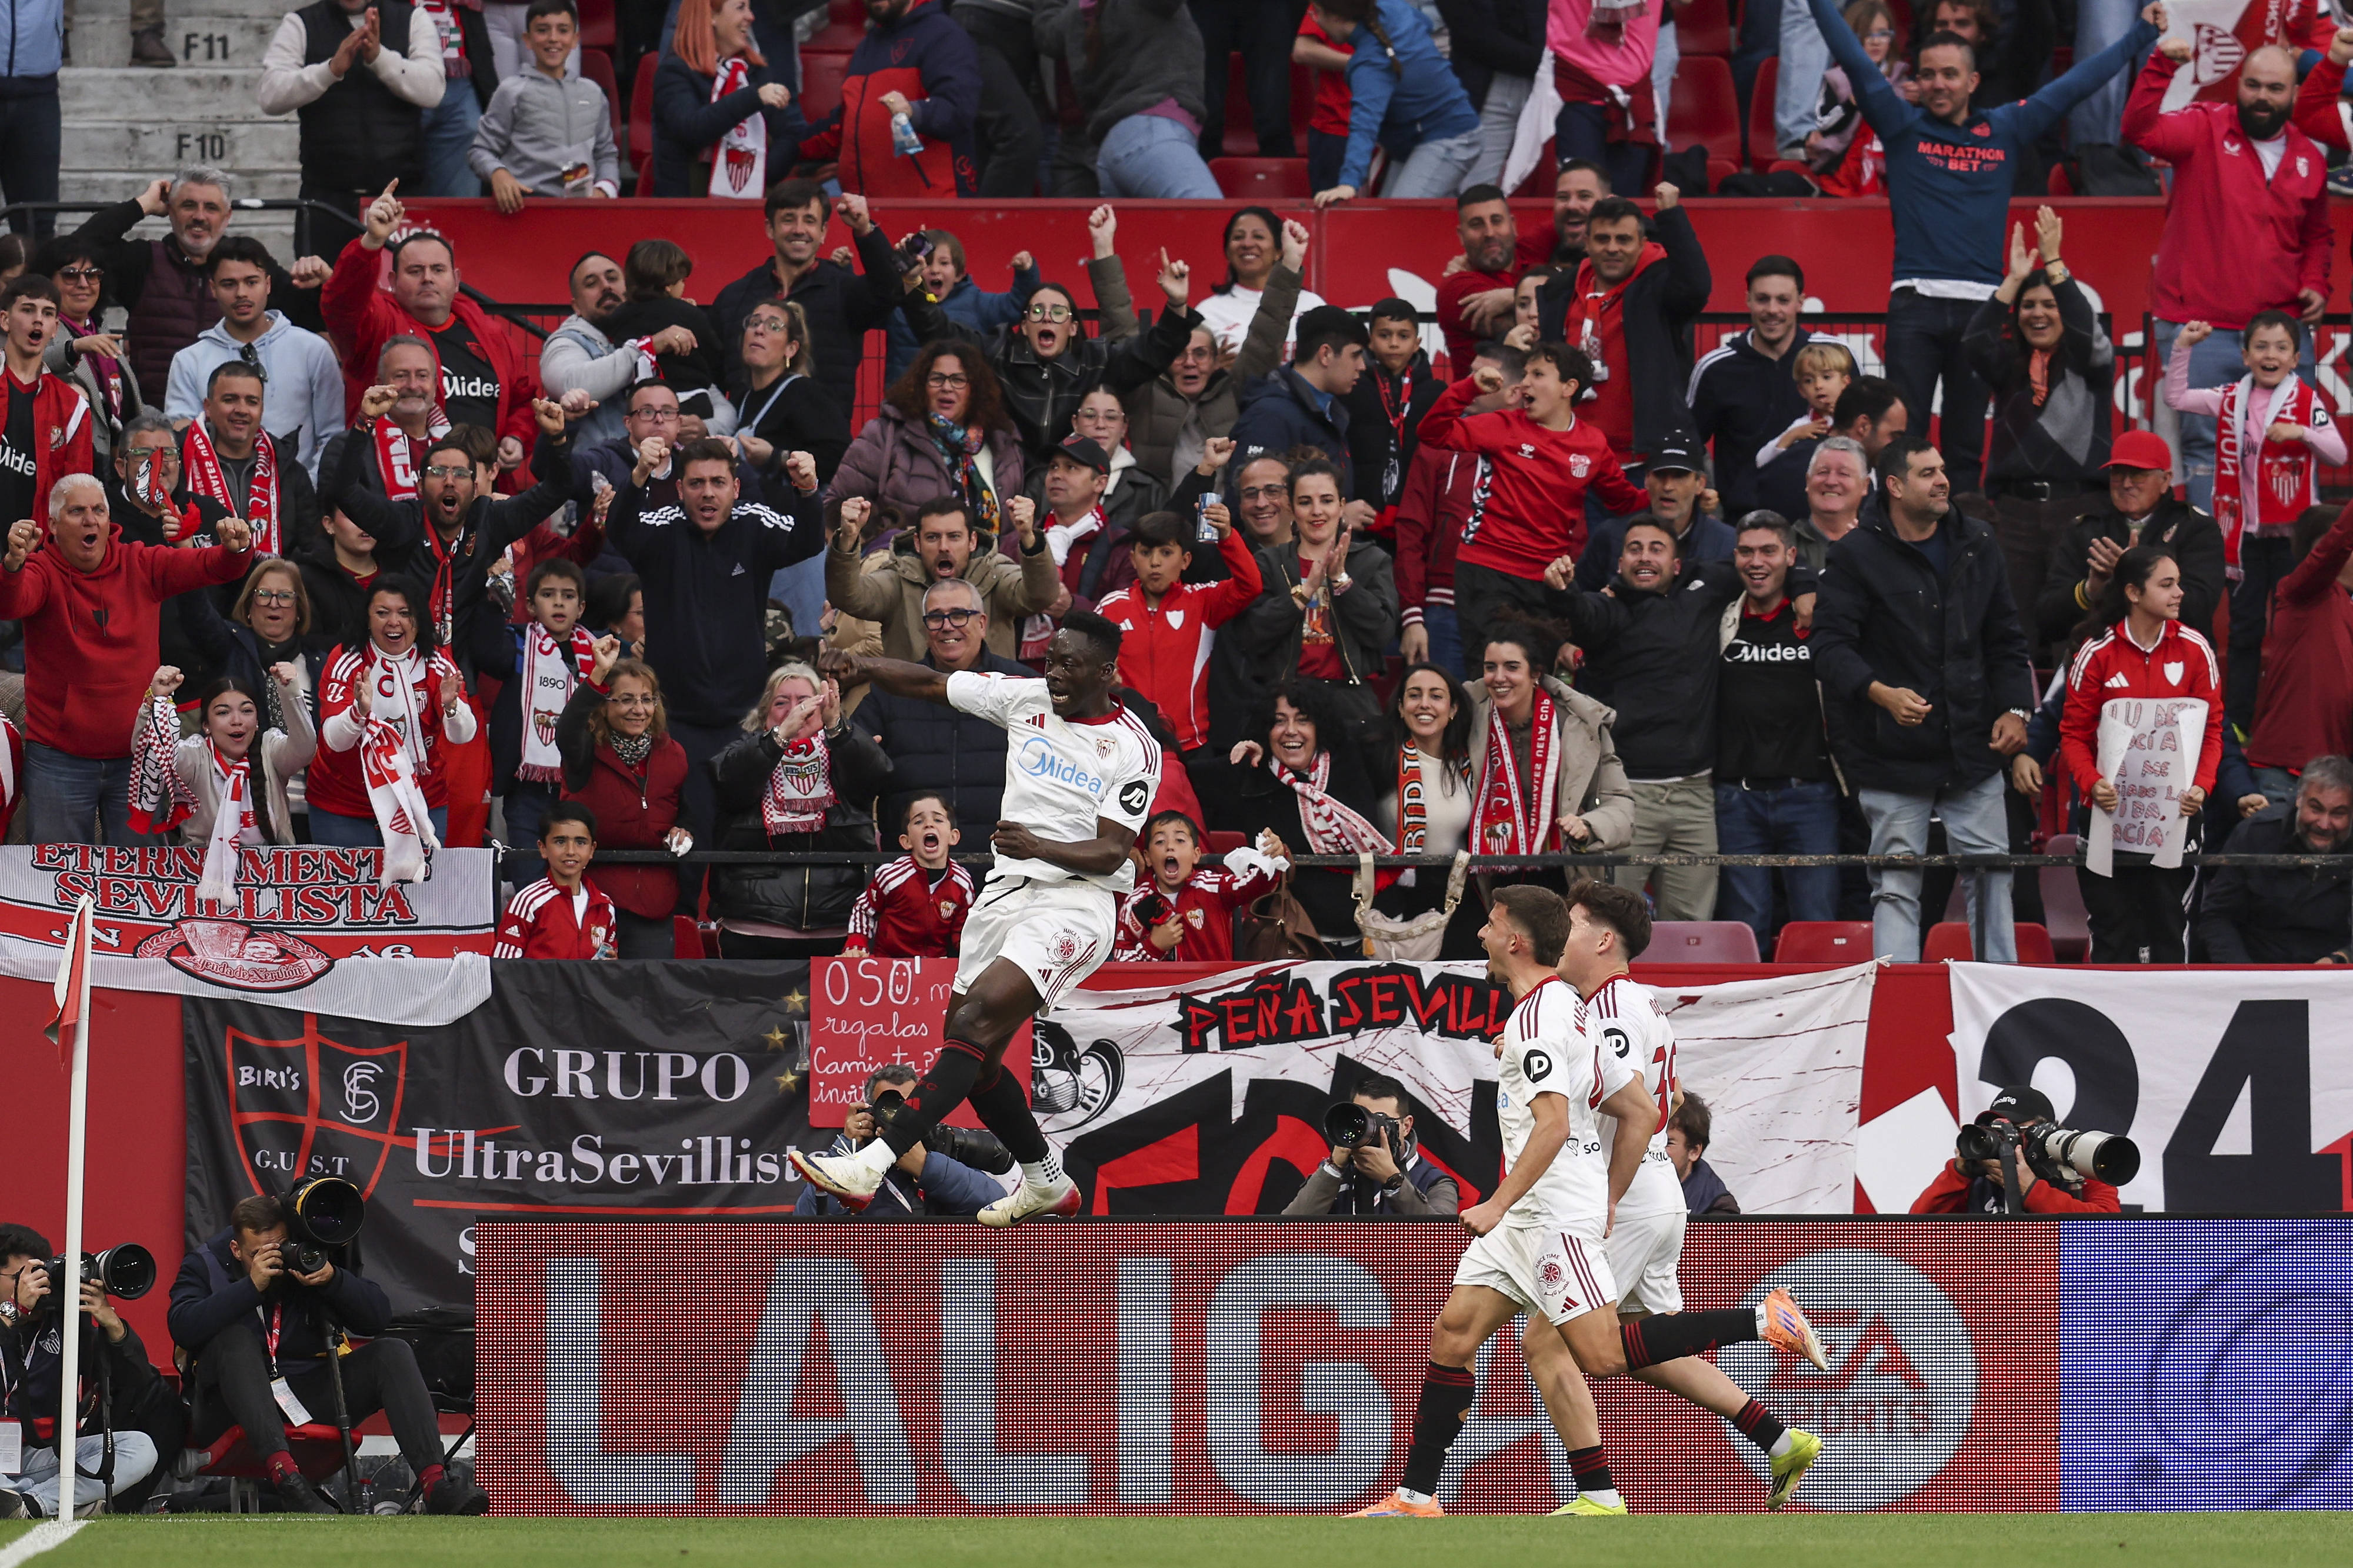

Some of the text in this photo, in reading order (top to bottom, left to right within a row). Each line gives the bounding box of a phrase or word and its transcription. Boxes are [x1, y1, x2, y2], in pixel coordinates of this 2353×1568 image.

[184, 33, 228, 60] F11
[177, 134, 224, 160] F10
[1918, 141, 2005, 161] MARATHON
[1948, 158, 1981, 172] BET
[0, 438, 36, 477] Mide
[1724, 640, 1811, 663] Midea
[539, 676, 566, 690] 1890
[1019, 745, 1102, 794] Midea
[1121, 787, 1146, 809] JD
[31, 845, 432, 882] ETERNMENT
[56, 870, 418, 926] SEVILLISTA
[1062, 928, 1078, 938] JUICE
[1188, 973, 1509, 1046] PEÑA SEVILL
[819, 1011, 928, 1057] regalas
[814, 1045, 935, 1075] Camista?
[1529, 1057, 1549, 1080] JD
[504, 1047, 751, 1102] GRUPO
[1978, 997, 2342, 1213] 24
[1535, 1255, 1546, 1270] JUICE
[546, 1254, 1621, 1507] LALIGA
